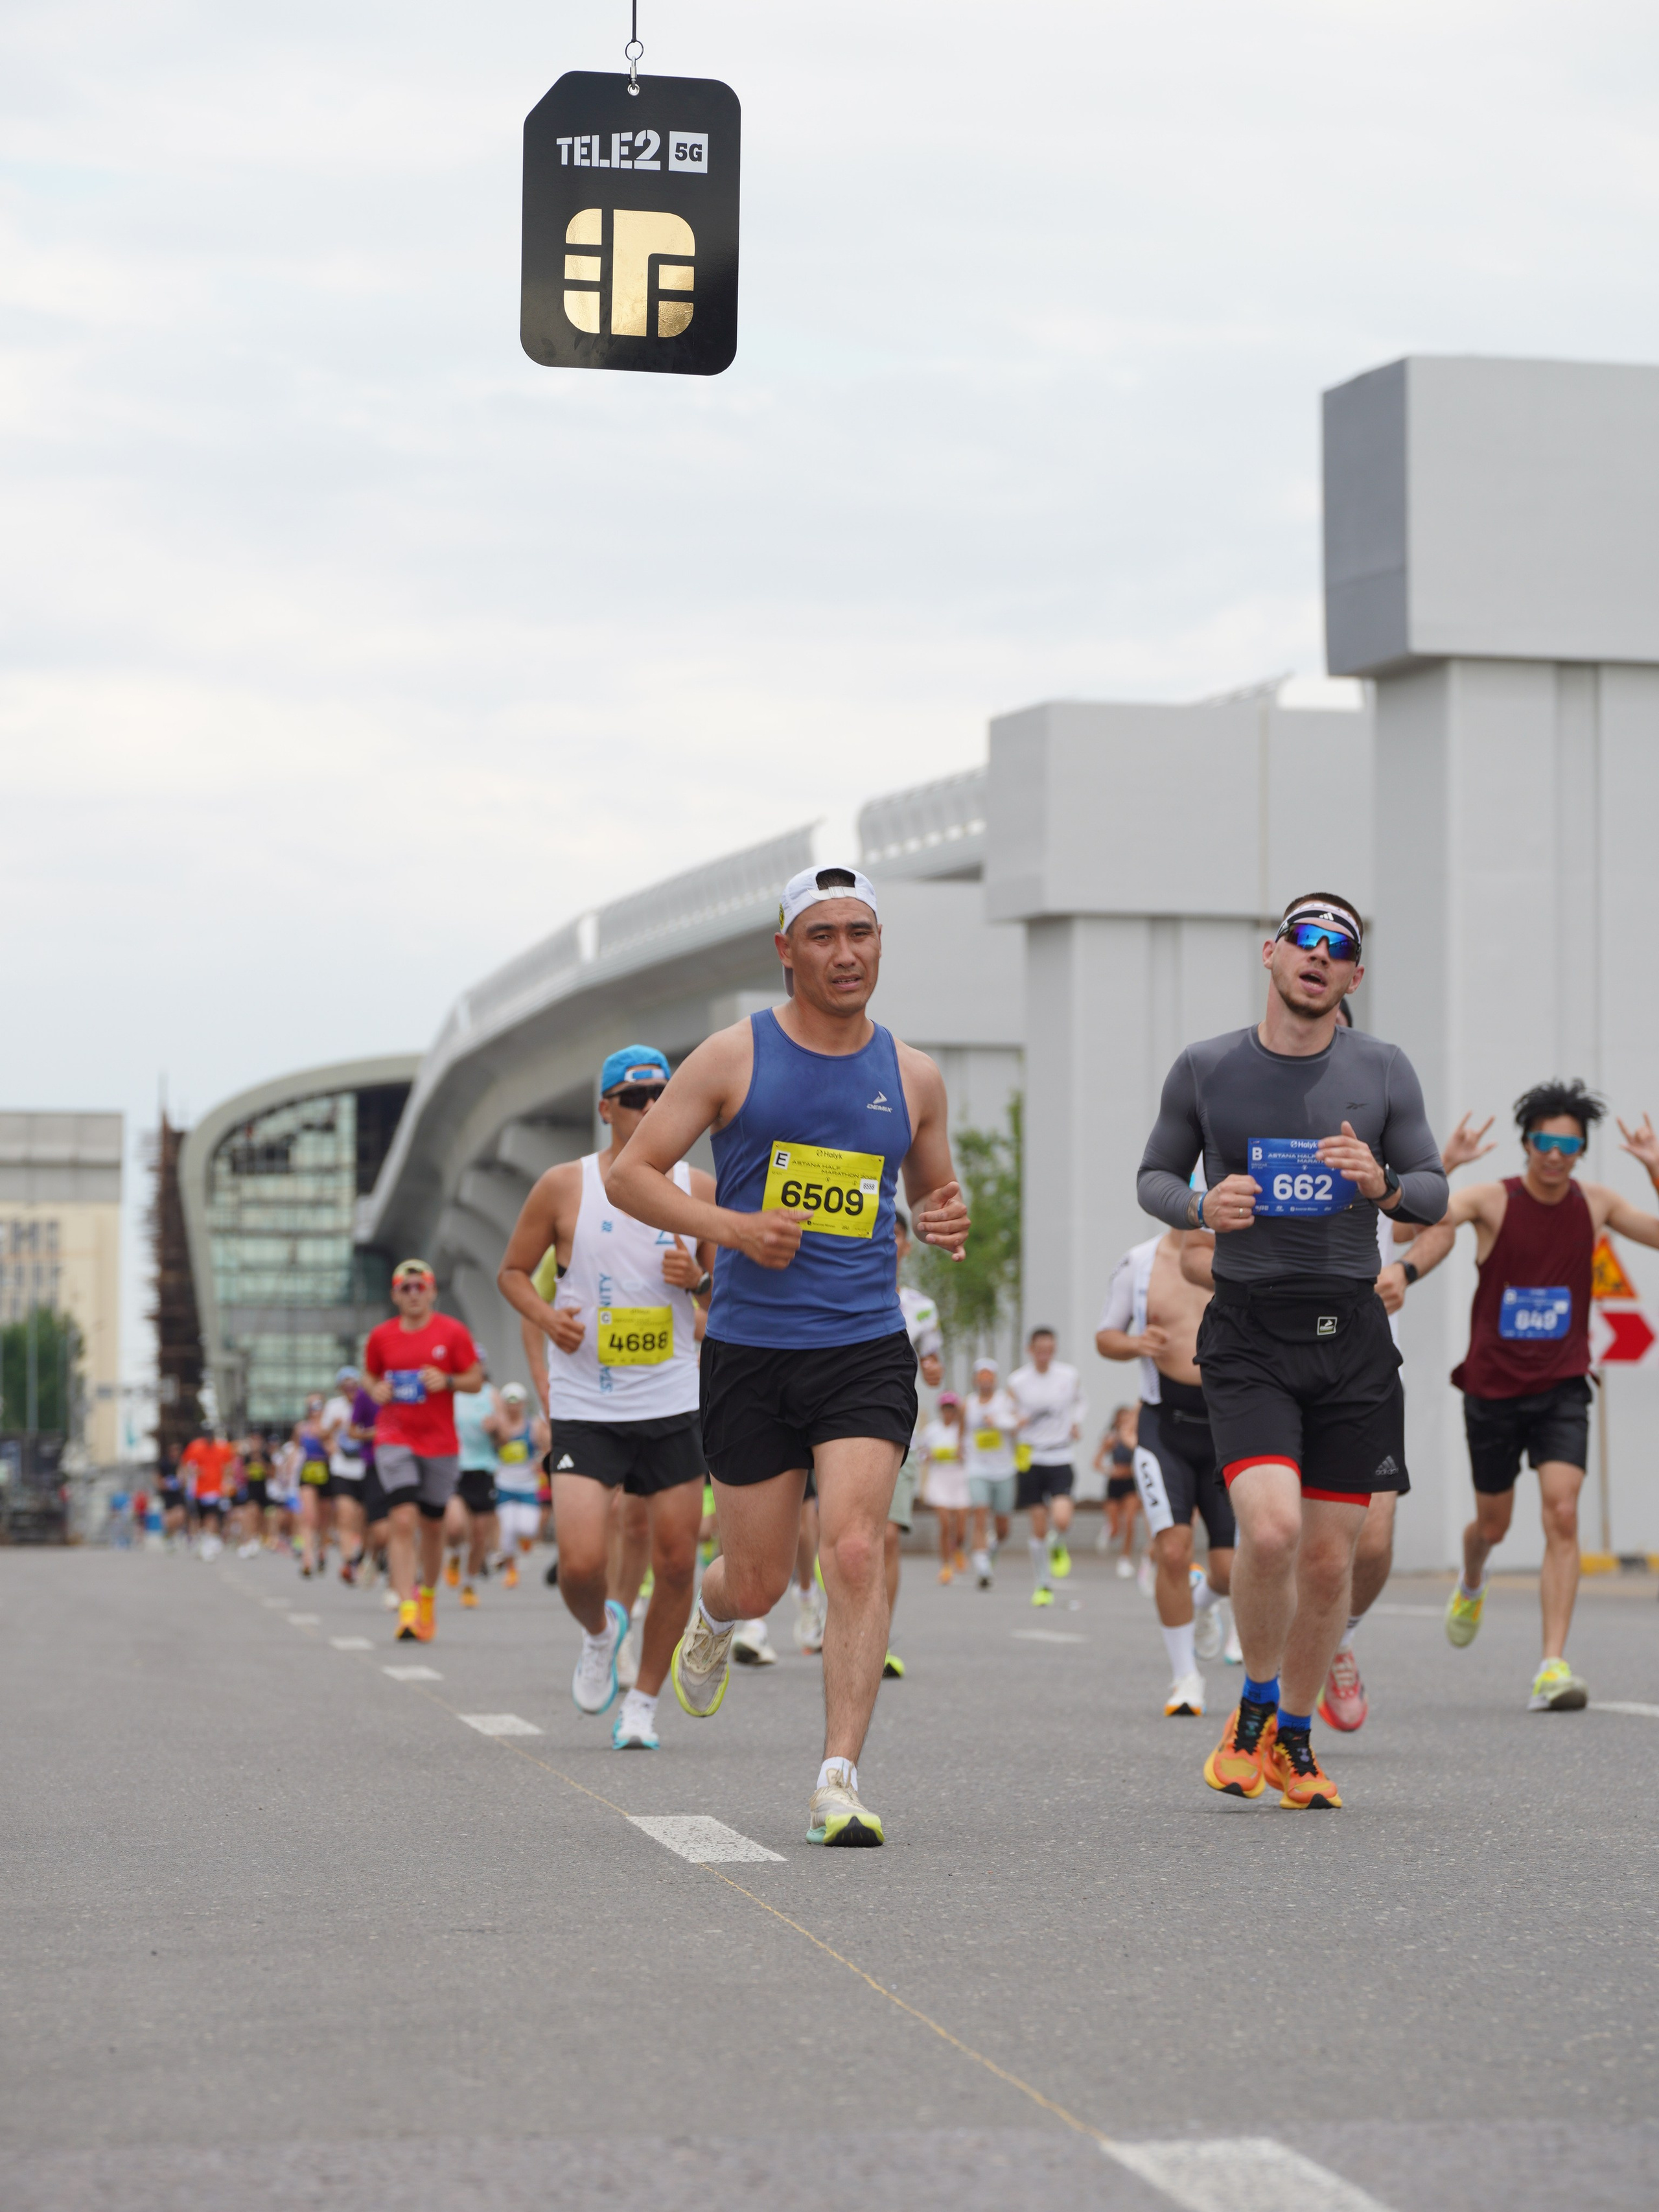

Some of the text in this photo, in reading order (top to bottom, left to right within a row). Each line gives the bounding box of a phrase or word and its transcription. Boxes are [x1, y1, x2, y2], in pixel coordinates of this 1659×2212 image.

[557, 130, 702, 170] TELE2 5G
[1252, 1147, 1263, 1161] B
[1298, 1141, 1317, 1149] Halyk
[776, 1152, 788, 1167] E
[824, 1150, 843, 1160] Halyk
[1273, 1174, 1333, 1201] 662
[781, 1180, 864, 1216] 6509
[609, 1331, 668, 1352] 4688
